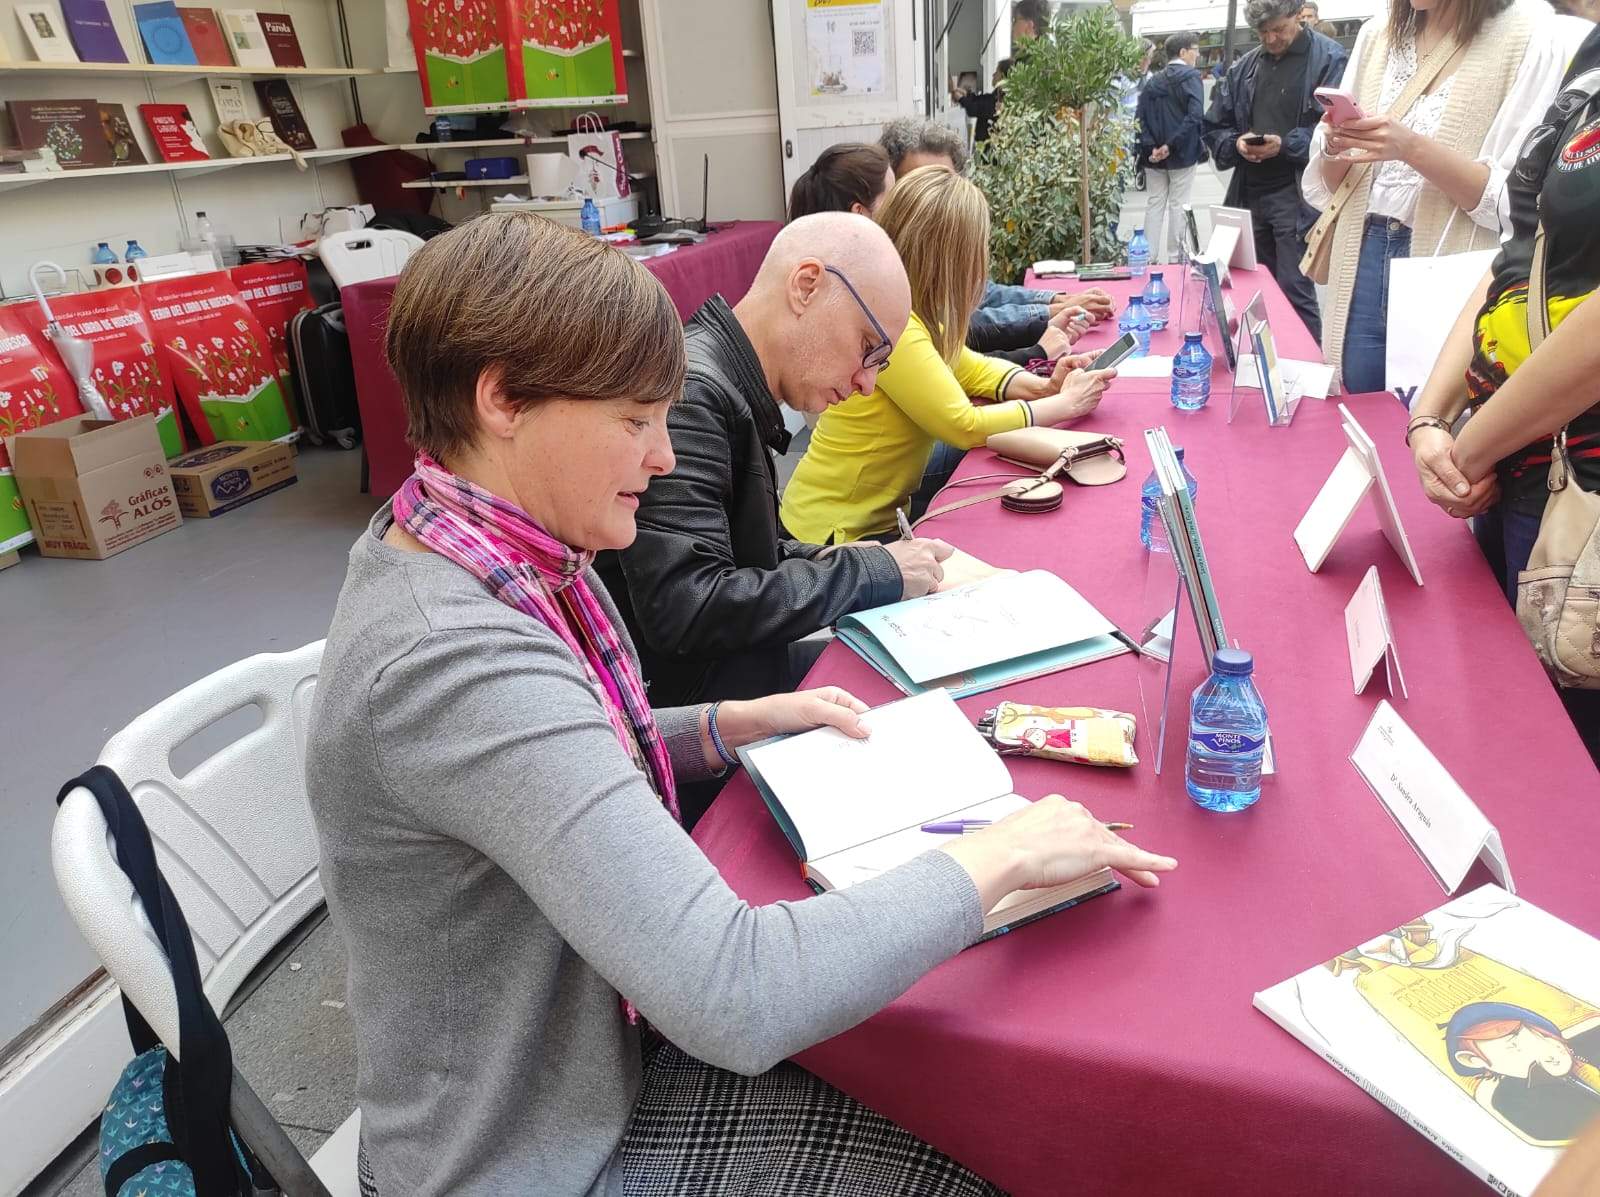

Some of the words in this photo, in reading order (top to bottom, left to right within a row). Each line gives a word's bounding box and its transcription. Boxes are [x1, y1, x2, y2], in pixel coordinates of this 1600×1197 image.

[149, 306, 171, 321] FERIA
[170, 304, 184, 317] DEL
[199, 298, 211, 311] DE
[0, 333, 32, 353] UESCA
[128, 485, 168, 507] Gráficas
[134, 496, 172, 519] ALÓS
[1397, 781, 1413, 804] Sandra
